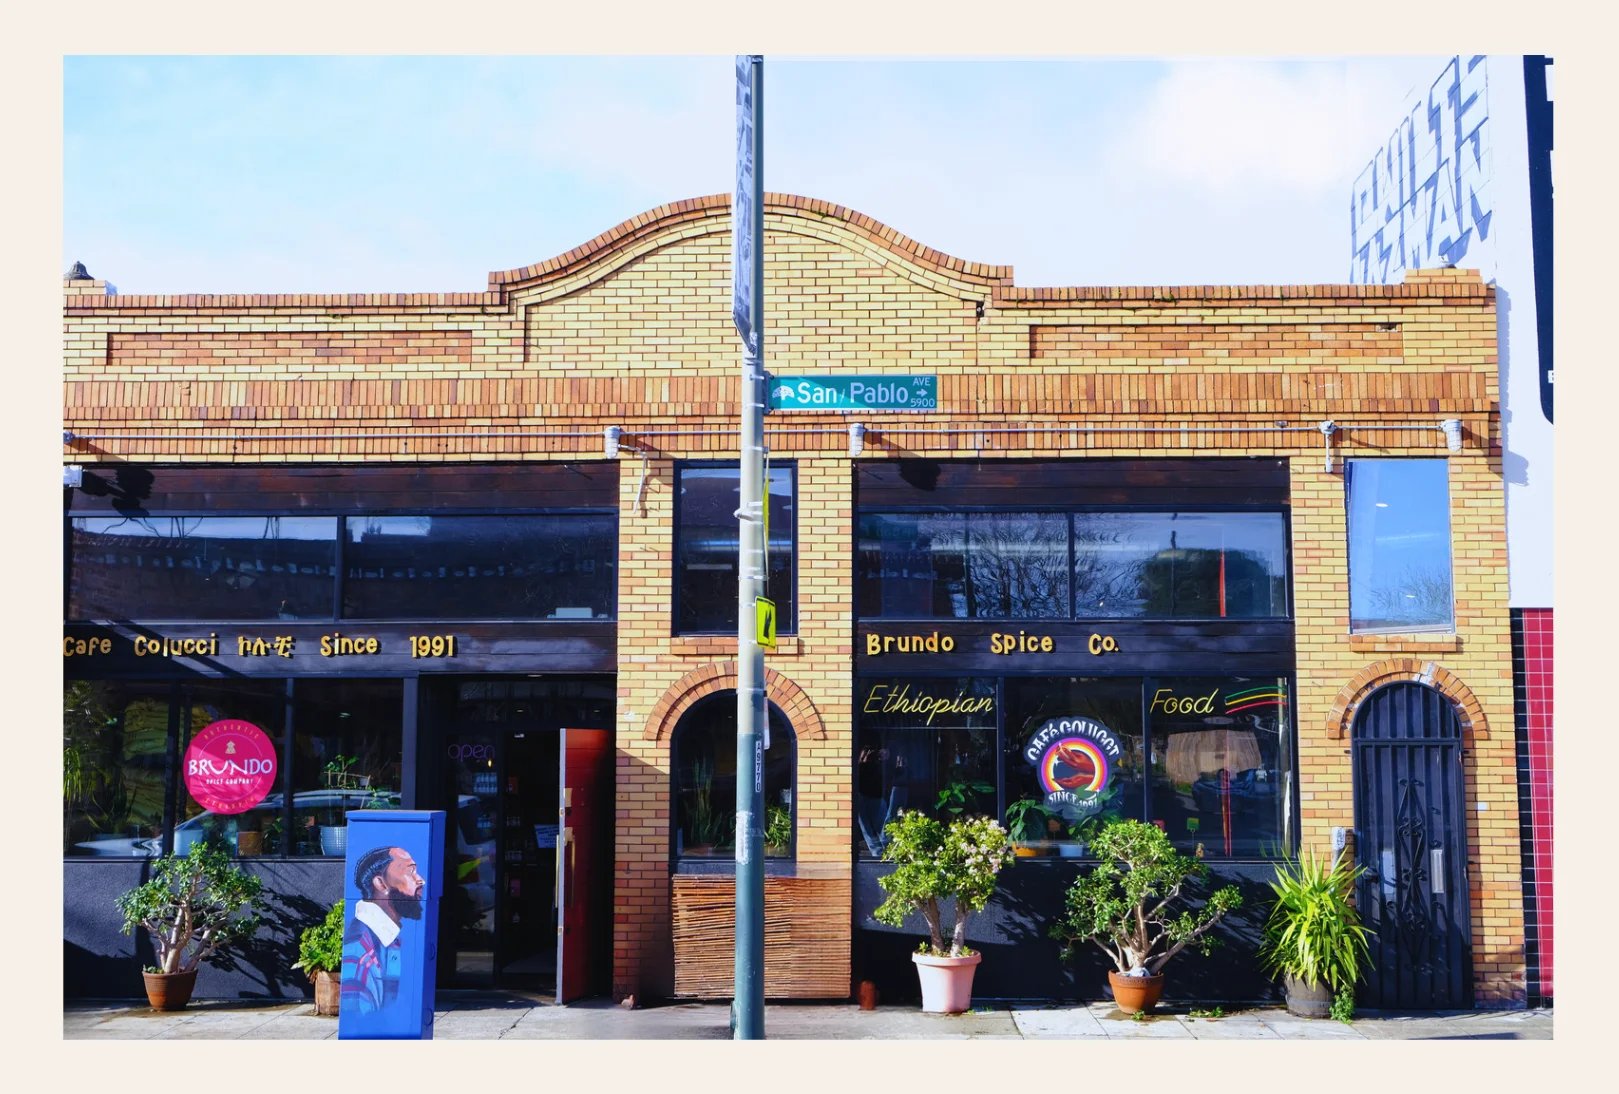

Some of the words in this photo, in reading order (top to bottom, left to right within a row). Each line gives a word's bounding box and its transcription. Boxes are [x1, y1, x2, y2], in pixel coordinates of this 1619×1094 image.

[797, 381, 837, 404] San
[849, 381, 909, 404] Pablo
[912, 377, 931, 386] AVE
[910, 397, 936, 408] 5900
[63, 634, 112, 657] Cafe
[134, 632, 217, 656] Colucci
[320, 632, 379, 656] Since
[410, 635, 455, 658] 1991
[866, 631, 955, 656] Brundo
[990, 631, 1054, 655] Spice
[1088, 633, 1120, 656] Co.
[863, 684, 994, 725] Ethiopian
[1149, 687, 1220, 716] Food
[448, 743, 496, 762] open
[188, 758, 273, 776] BRUNDO
